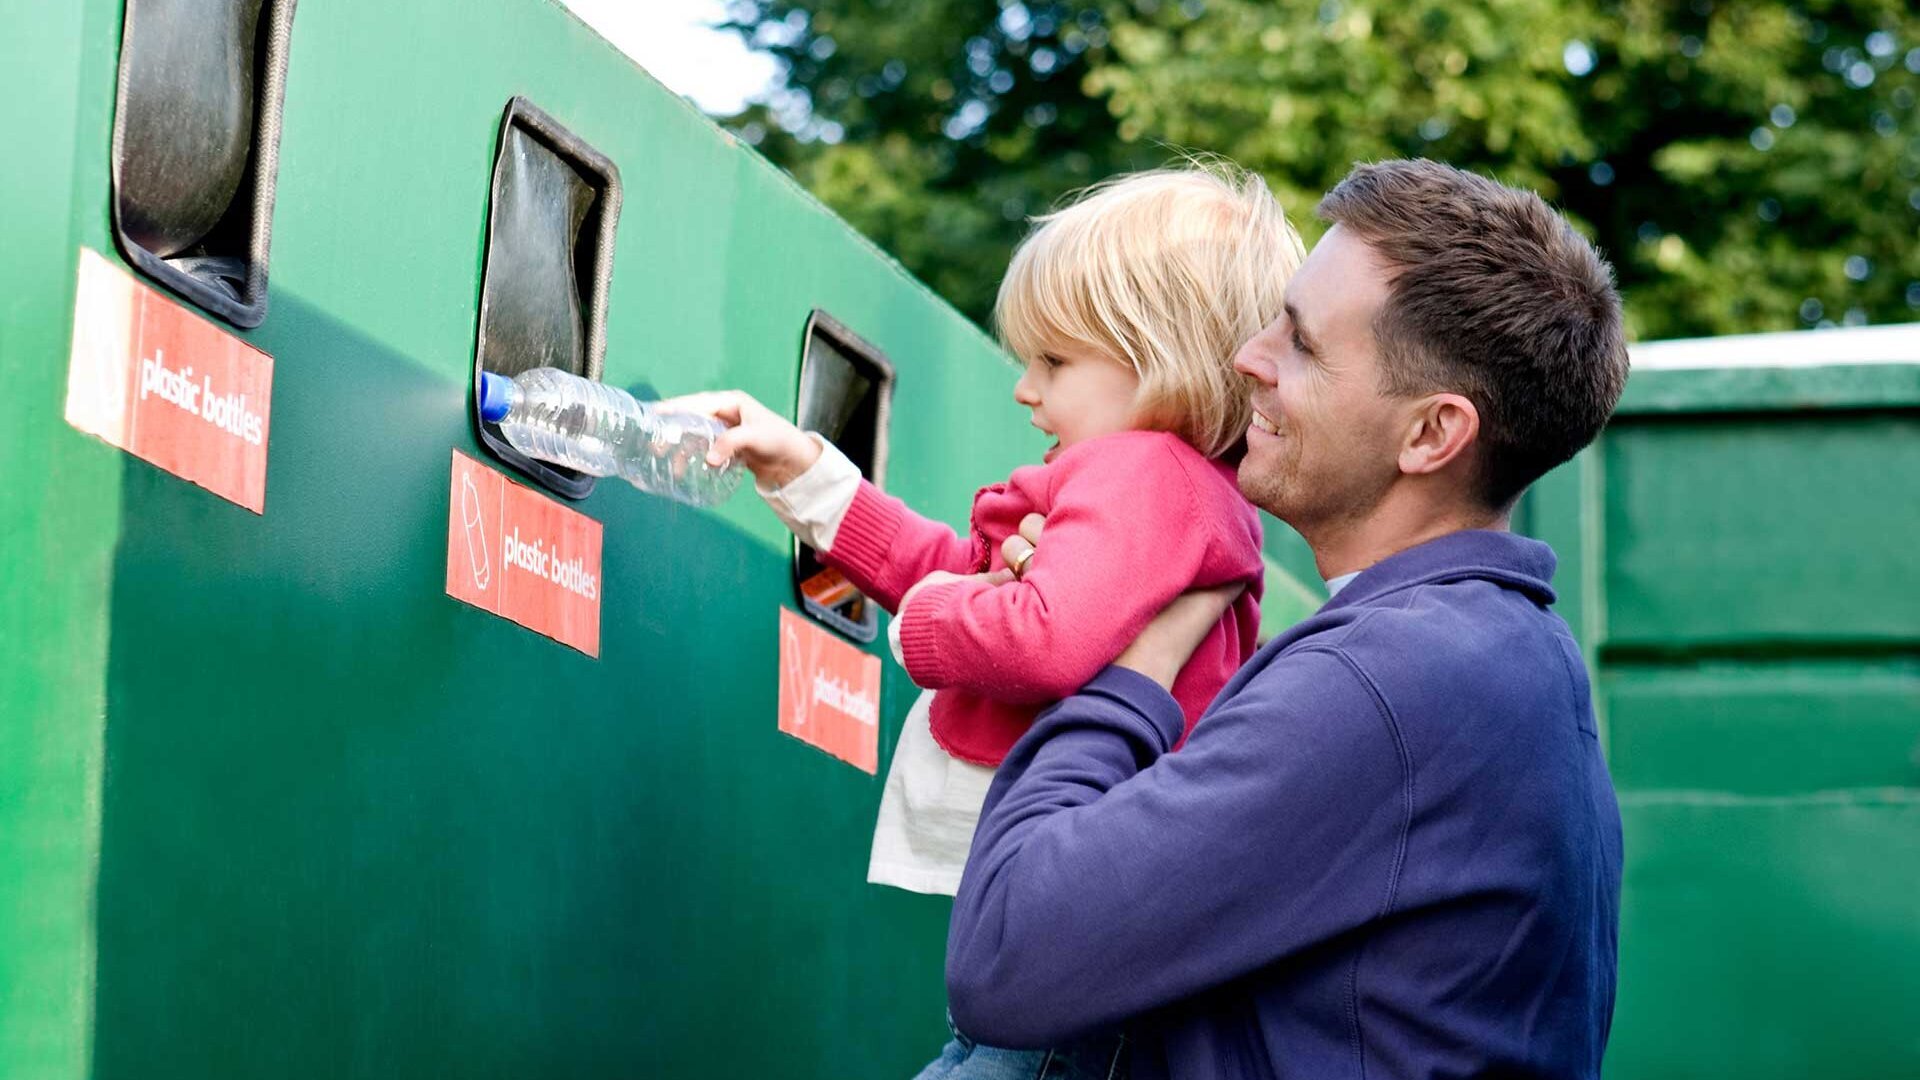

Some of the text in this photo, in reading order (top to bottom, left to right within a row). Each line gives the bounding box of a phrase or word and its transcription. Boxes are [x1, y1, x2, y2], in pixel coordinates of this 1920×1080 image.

[141, 349, 263, 446] plastic bottles
[504, 526, 596, 600] plastic bottles
